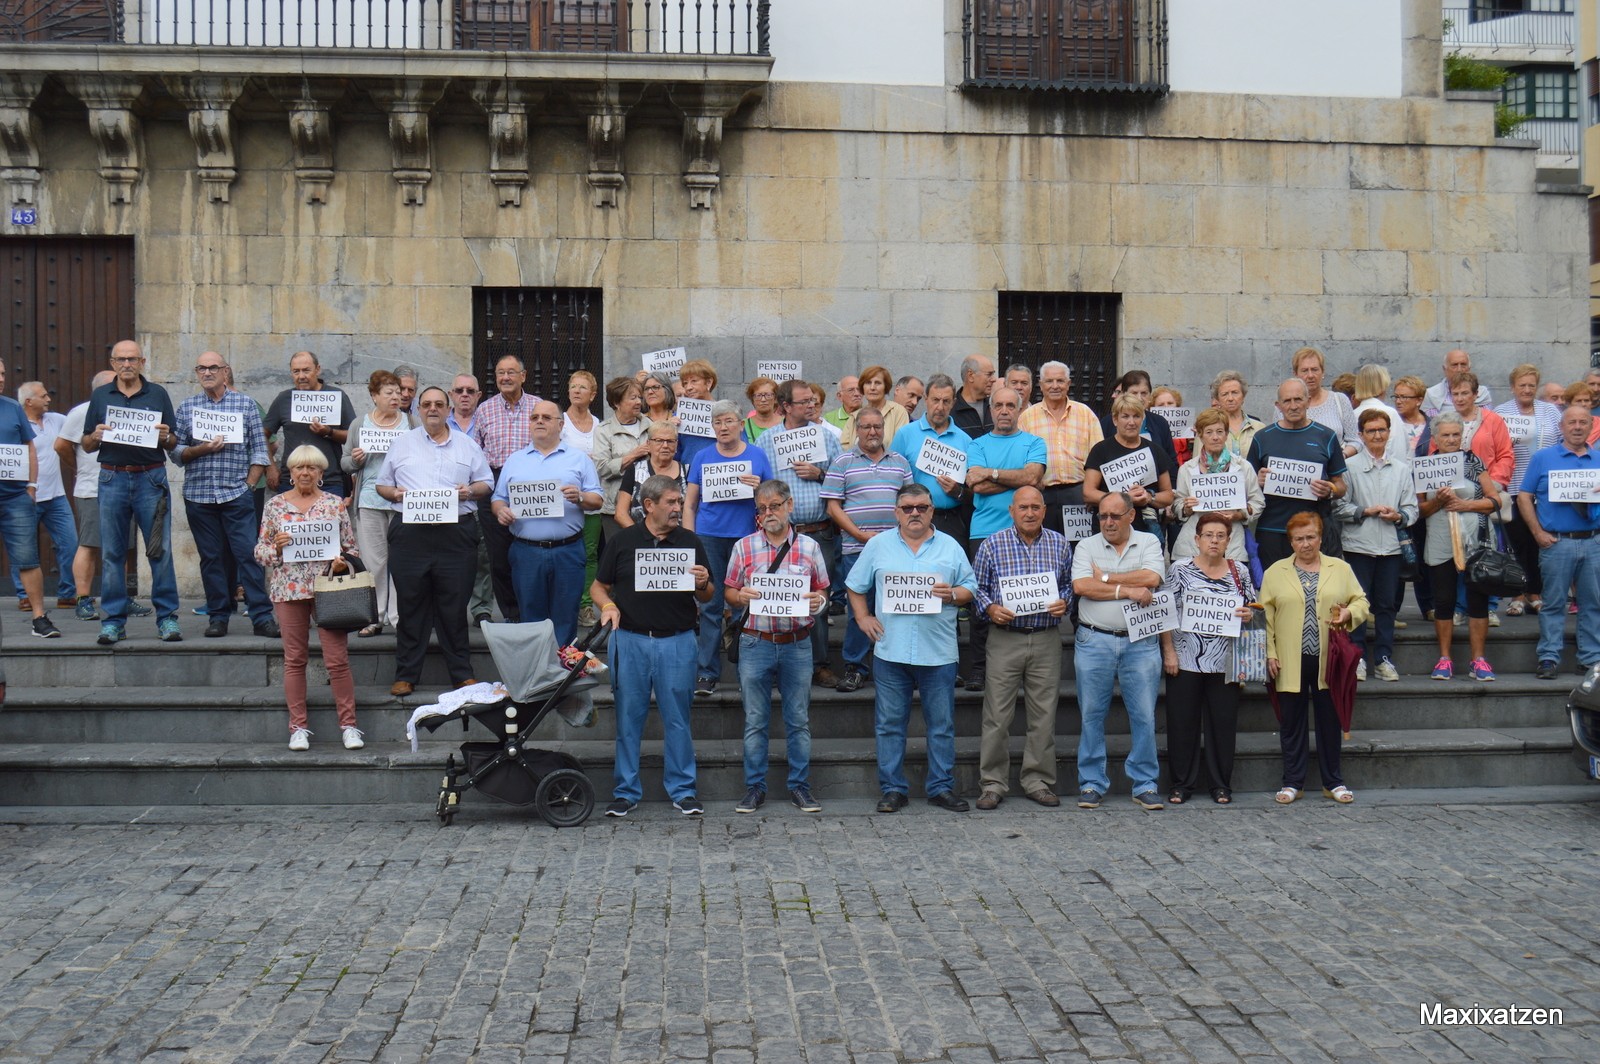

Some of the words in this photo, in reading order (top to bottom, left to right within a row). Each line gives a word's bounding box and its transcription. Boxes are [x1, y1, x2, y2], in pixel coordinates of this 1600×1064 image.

[14, 209, 34, 223] 43
[293, 393, 336, 402] PENTSIO
[295, 405, 333, 413] DUINEN
[679, 401, 712, 412] PENTS
[108, 408, 155, 422] PENTSIO
[194, 410, 237, 423] PENTSIO
[680, 412, 711, 424] DUINE
[109, 420, 151, 433] DUINEN
[196, 421, 235, 432] DUINEN
[1503, 416, 1530, 426] NTSIO
[684, 425, 710, 436] ALDE
[113, 433, 142, 444] ALDE
[202, 432, 229, 442] ALE
[773, 428, 817, 445] PENTSIO
[0, 447, 23, 456] TSIO
[777, 440, 817, 456] DUINEN
[924, 439, 966, 462] PENTSIO
[0, 459, 21, 467] NEN
[922, 450, 961, 472] DUINEN
[1102, 452, 1146, 475] PENTSIO
[1415, 455, 1458, 468] PENTSIO
[703, 463, 746, 475] PENTSIO
[1270, 460, 1316, 474] PENTSIO
[1, 470, 15, 479] DE
[1109, 464, 1149, 486] DUINEN
[1270, 472, 1312, 486] DUINEN
[1418, 467, 1457, 480] DUINEN
[1550, 471, 1597, 479] PENTSIO
[1191, 475, 1238, 487] PENTSIO
[1553, 481, 1594, 489] DUINEN
[510, 482, 556, 493] PENTSIO
[1274, 485, 1303, 497] ALDE
[405, 490, 452, 498] PENTSIO
[712, 488, 739, 499] ALDE
[1195, 488, 1236, 499] DUINEN
[1559, 491, 1588, 500] ALDE
[407, 501, 449, 510] DUINEN
[513, 495, 555, 505] DUINEN
[1203, 500, 1231, 510] ALDE
[521, 507, 550, 517] ALDE
[1064, 507, 1093, 516] PENT
[413, 513, 443, 522] ALDE
[1067, 519, 1091, 527] DUIN
[283, 522, 333, 534] PENTSIO
[1075, 530, 1093, 538] ALD
[294, 549, 325, 559] ALDE
[637, 552, 688, 562] PENTSIO
[640, 566, 685, 576] DUINEN
[646, 579, 678, 589] ALDE
[752, 576, 804, 589] PENTSIO
[885, 575, 936, 586] PENTSIO
[1001, 575, 1050, 589] PENTSIO
[887, 589, 932, 599] DUINEN
[1006, 588, 1050, 601] DUINEN
[1123, 594, 1169, 614] PESIO
[1186, 594, 1237, 609] PENTSIO
[761, 604, 792, 615] ALDE
[894, 602, 925, 613] ALDE
[1015, 601, 1045, 614] ALDE
[1130, 608, 1169, 627] DUINEN
[1187, 607, 1232, 622] DUINEN
[1138, 622, 1164, 638] ALDE
[1192, 622, 1224, 634] ALDE
